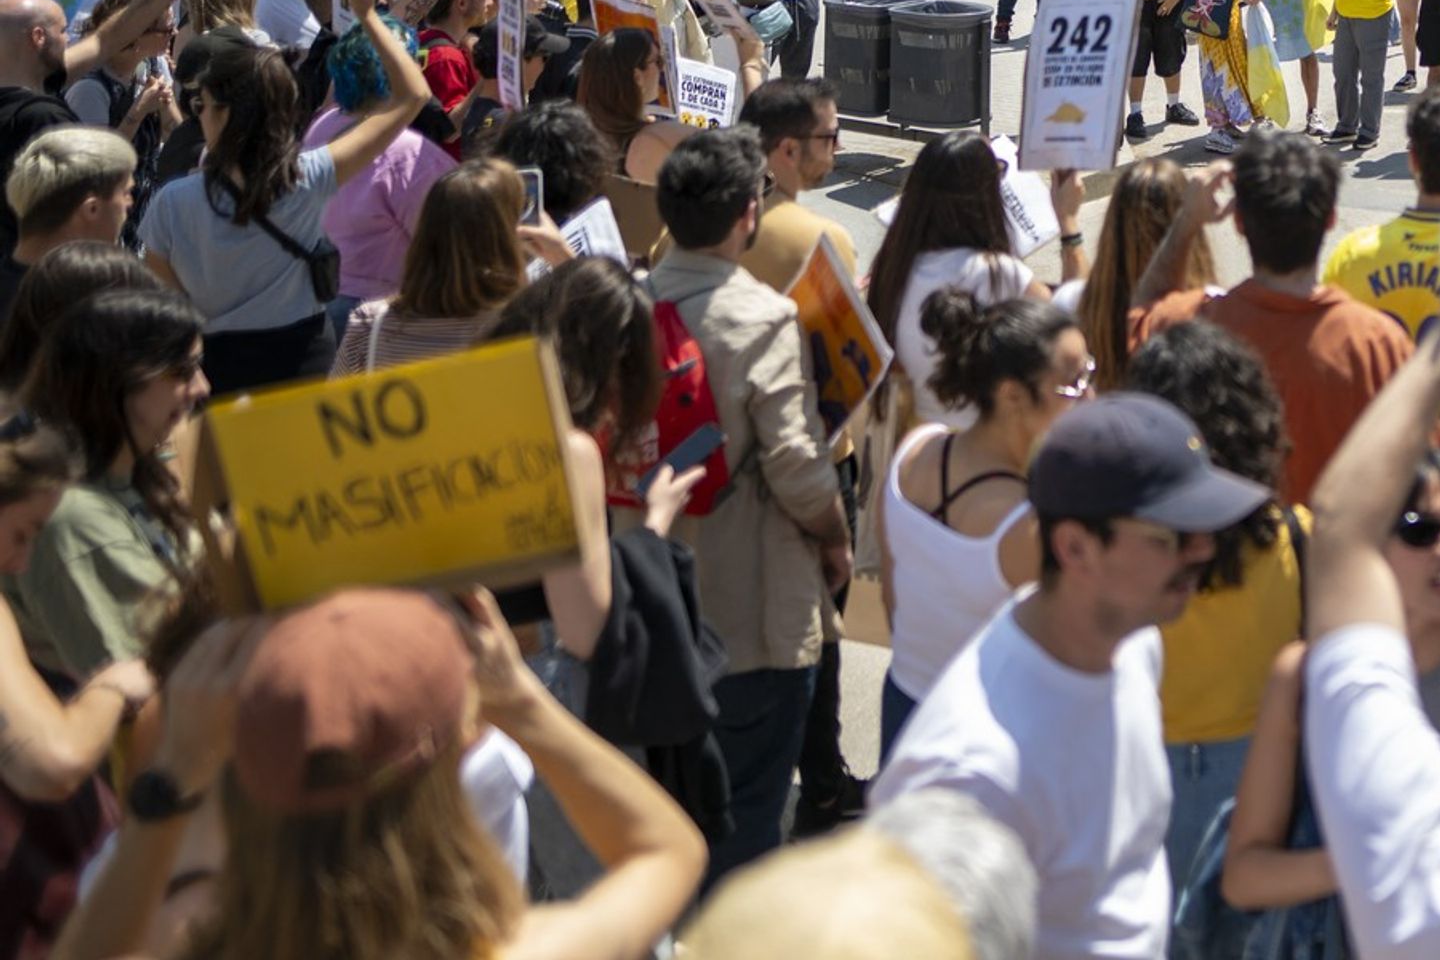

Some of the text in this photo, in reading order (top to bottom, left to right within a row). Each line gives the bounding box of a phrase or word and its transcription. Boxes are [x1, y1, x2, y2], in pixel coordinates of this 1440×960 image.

[1046, 13, 1113, 56] 242
[681, 80, 726, 101] COMPRAN
[687, 93, 698, 104] DE
[699, 95, 718, 109] CADA
[315, 377, 428, 460] NO
